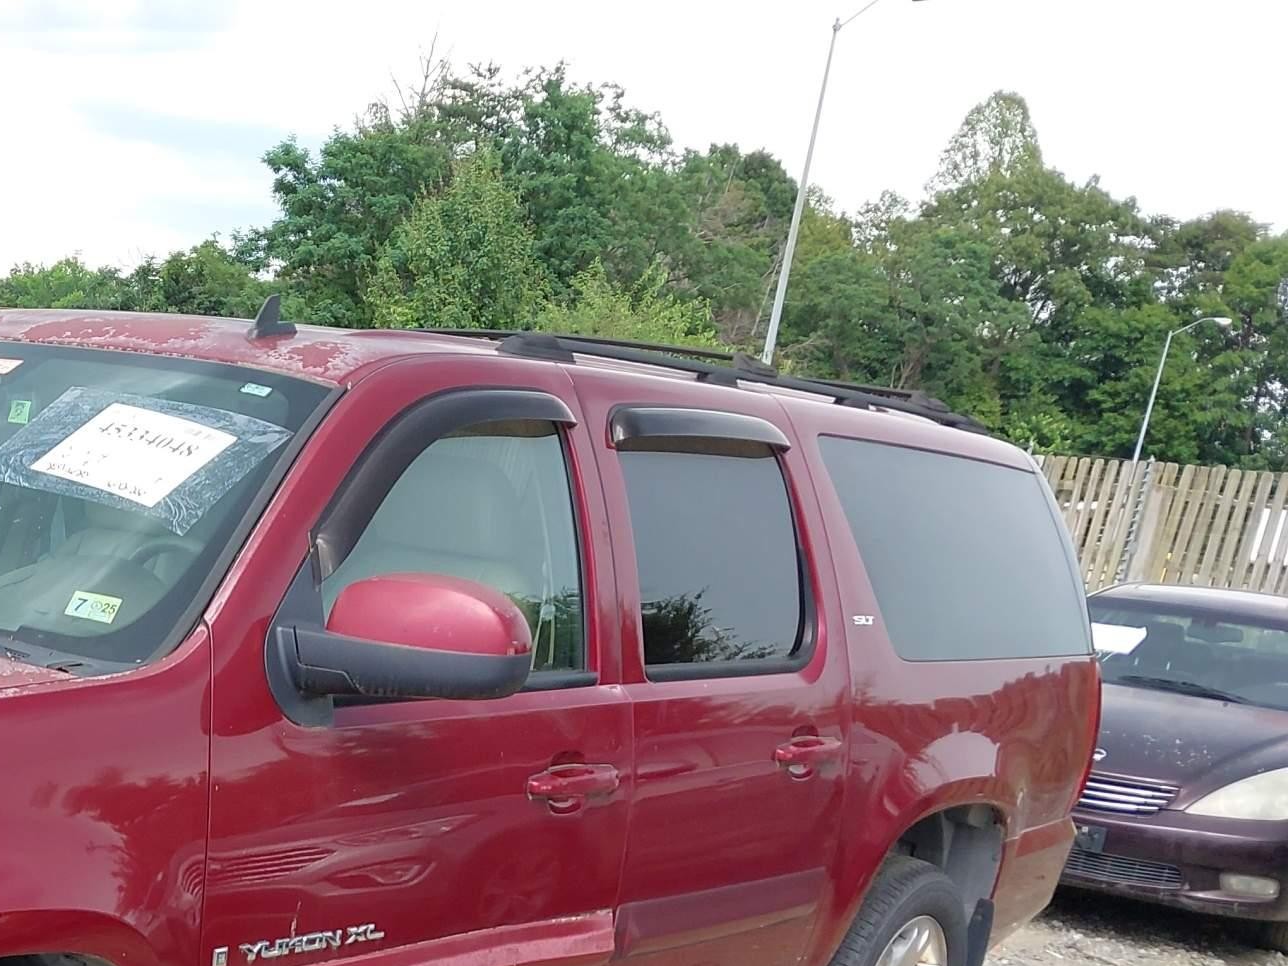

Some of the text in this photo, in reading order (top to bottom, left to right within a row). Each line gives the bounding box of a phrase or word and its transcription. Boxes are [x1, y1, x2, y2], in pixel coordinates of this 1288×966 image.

[74, 597, 117, 615] 7 25
[238, 929, 342, 963] YUKON
[344, 922, 385, 945] XL
